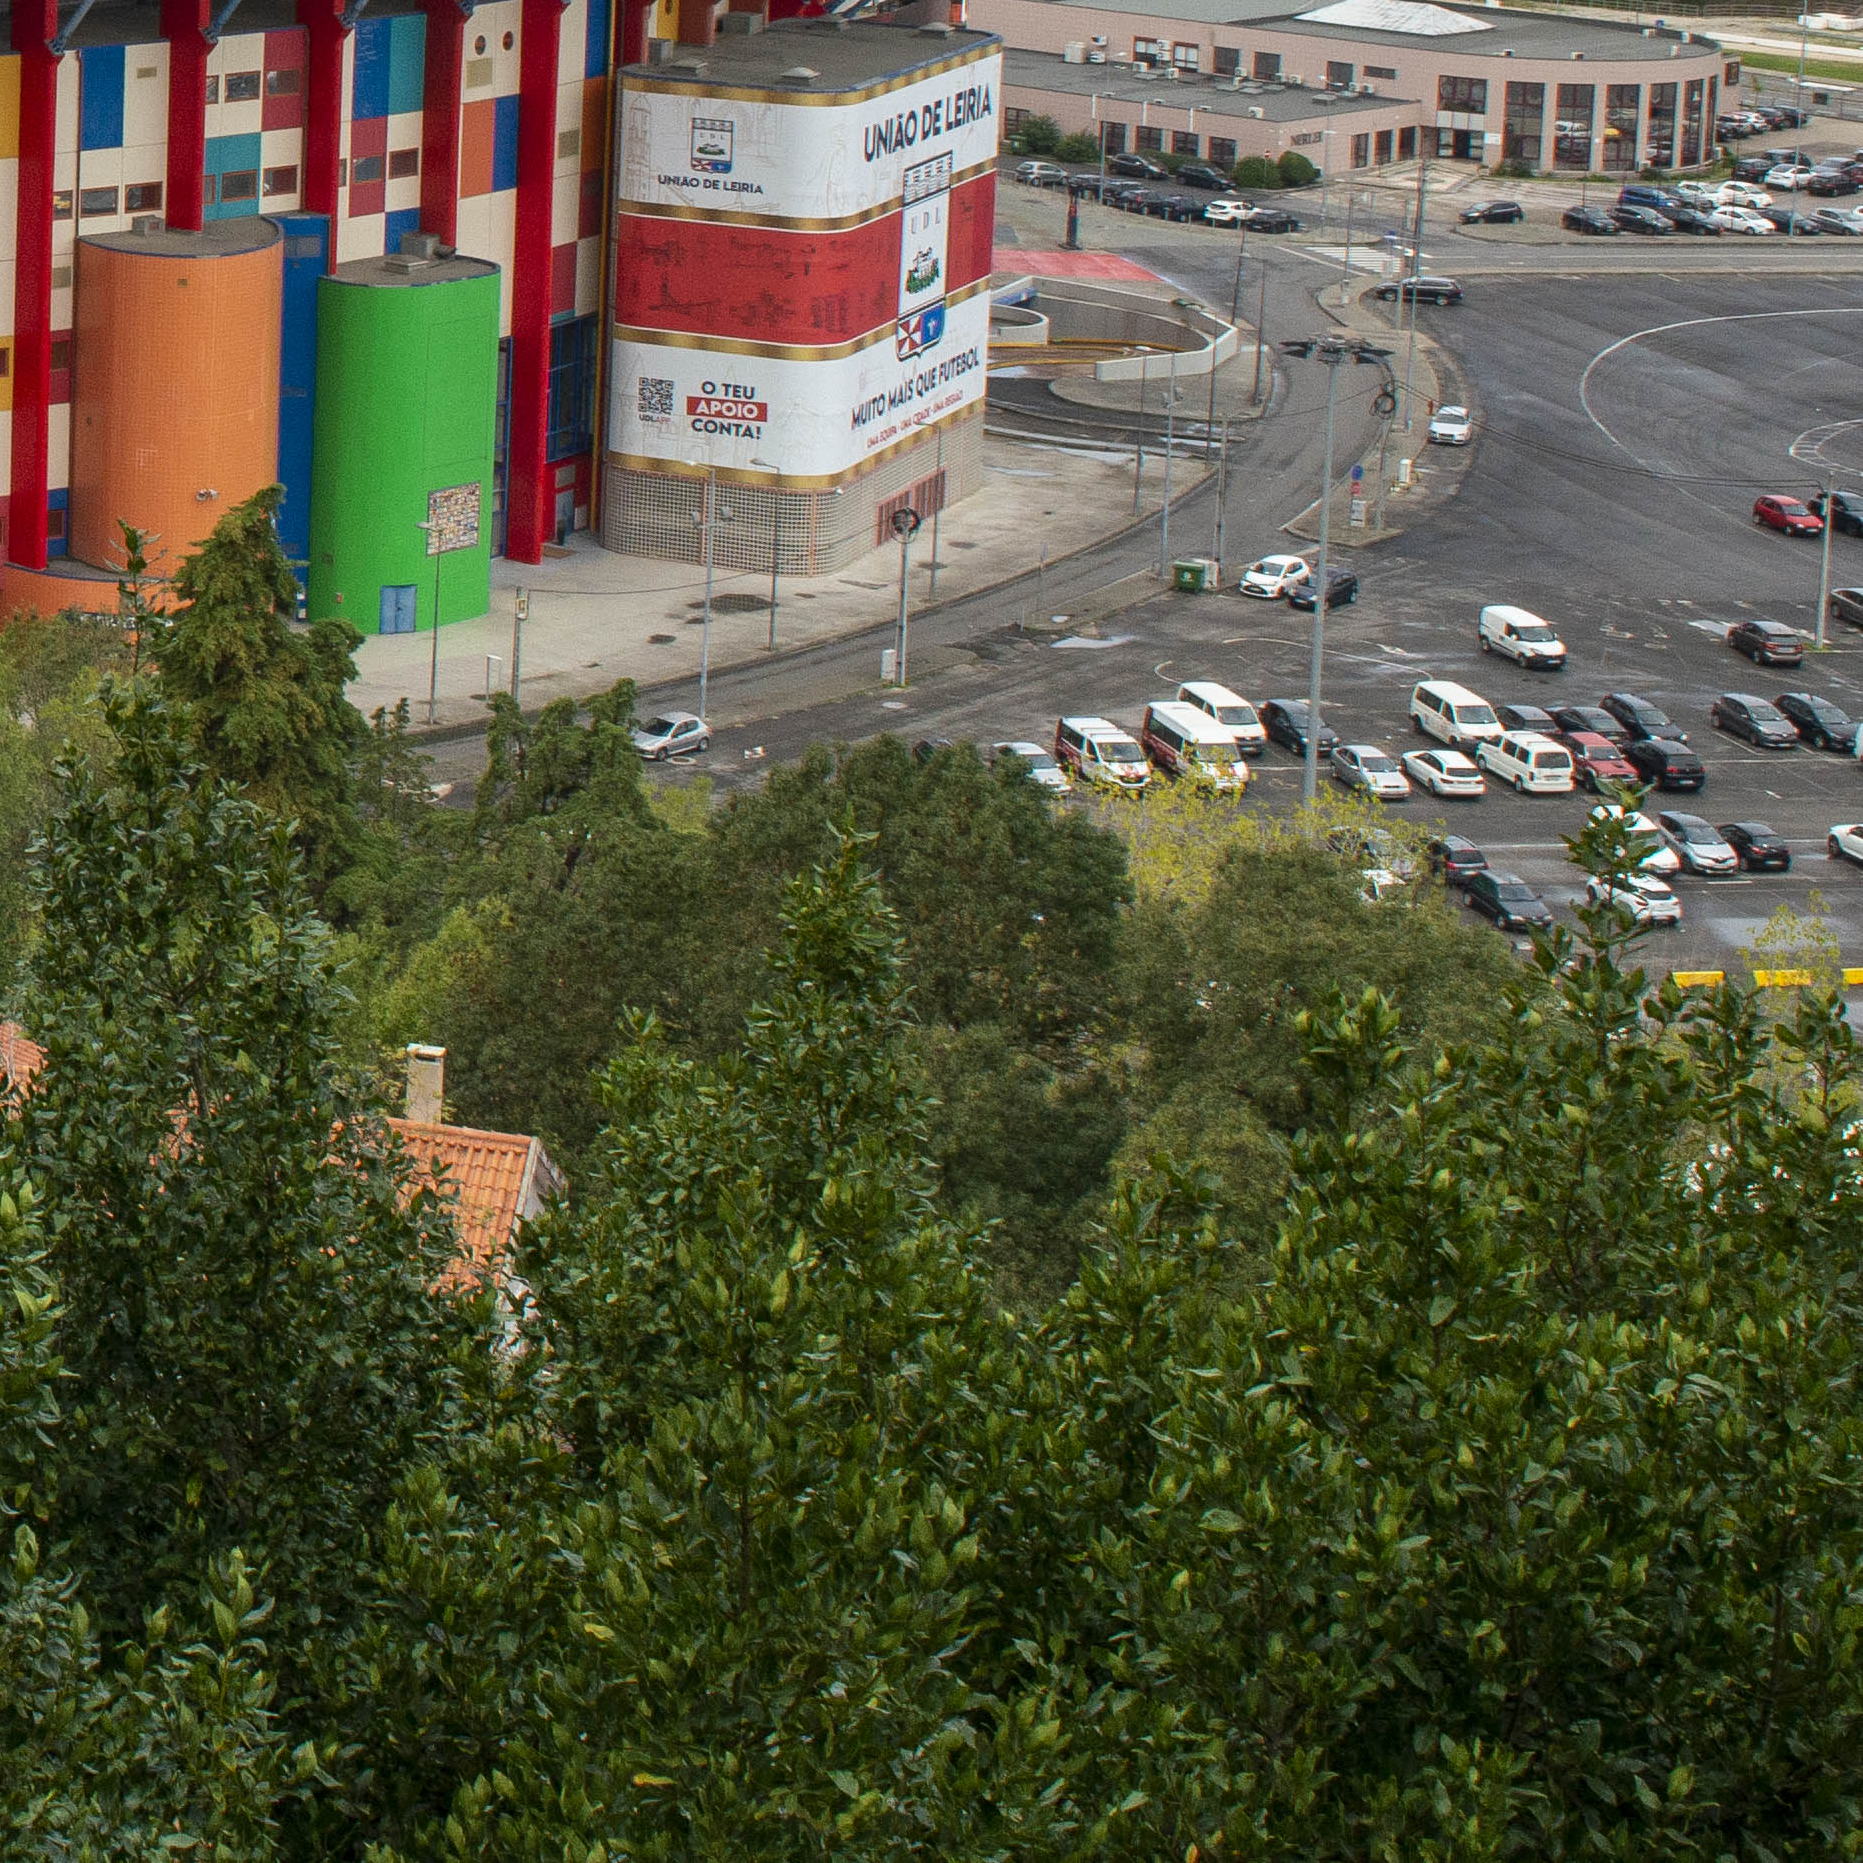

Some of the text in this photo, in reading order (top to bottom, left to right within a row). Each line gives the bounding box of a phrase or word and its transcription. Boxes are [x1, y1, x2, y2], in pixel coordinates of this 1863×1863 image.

[863, 84, 992, 162] UNIÃO DE LEIRIA
[658, 174, 764, 195] UNIÃO DE LEIRIA
[701, 381, 756, 400] O TEU
[851, 346, 979, 430] MUITO MAIS QUE FUTEBOL
[695, 400, 758, 419] APOIO
[691, 418, 762, 440] CONTA!
